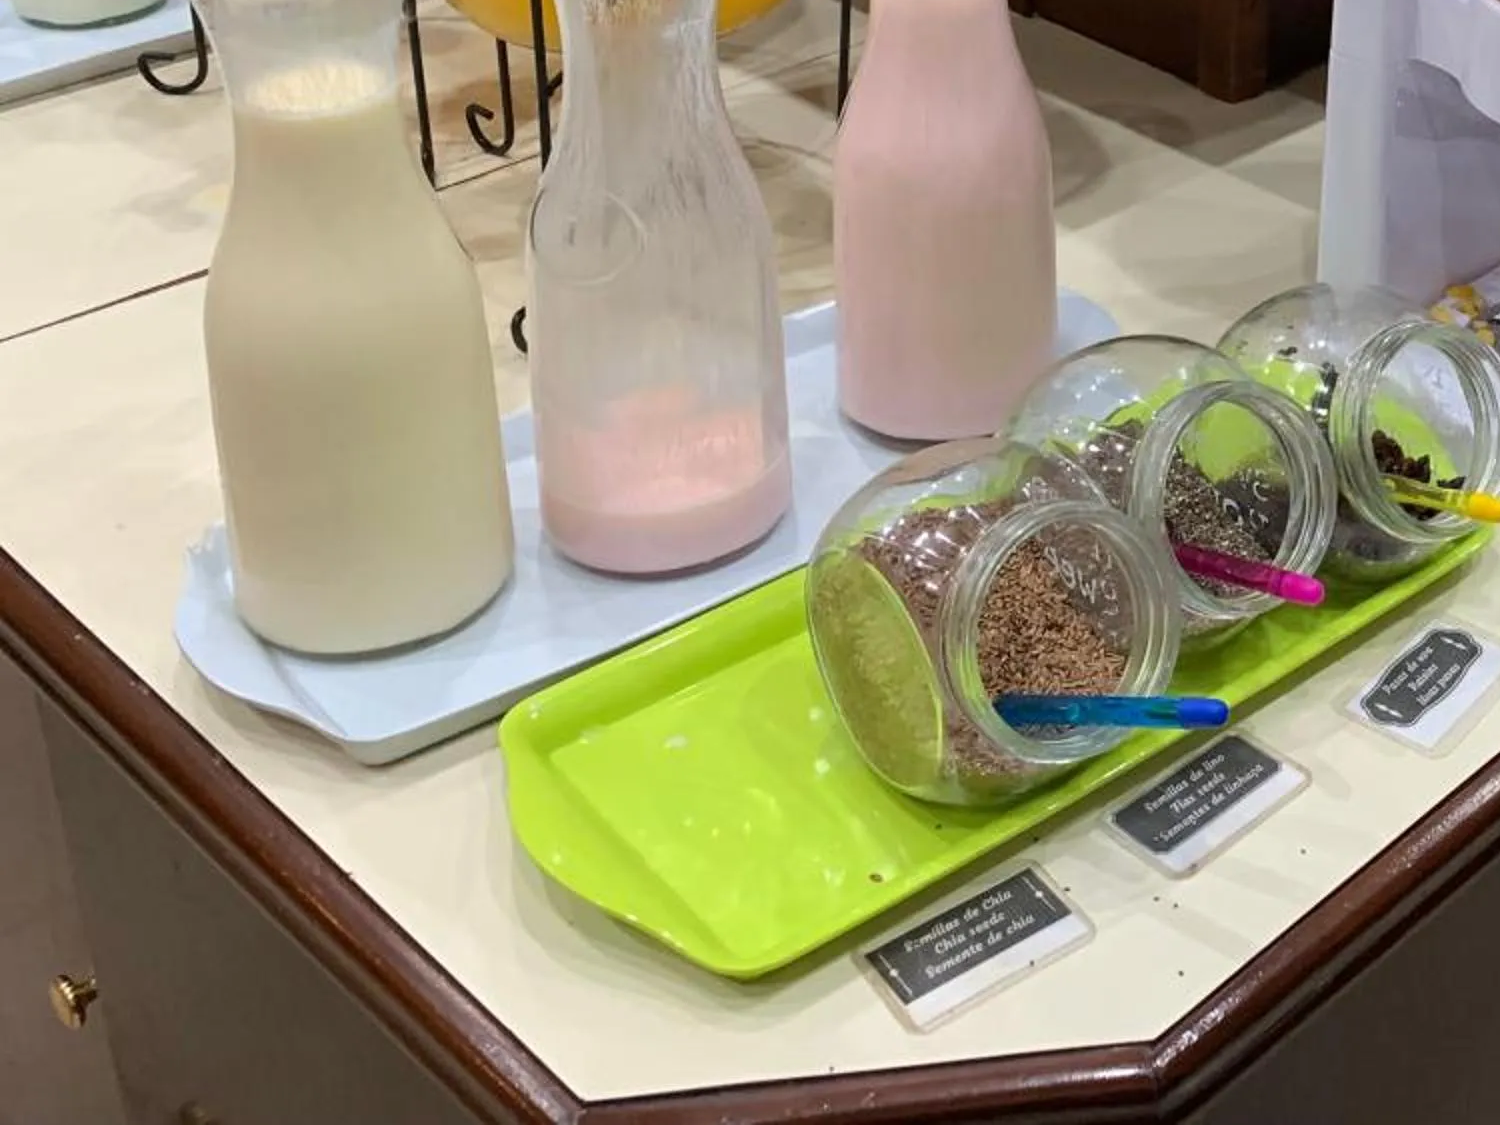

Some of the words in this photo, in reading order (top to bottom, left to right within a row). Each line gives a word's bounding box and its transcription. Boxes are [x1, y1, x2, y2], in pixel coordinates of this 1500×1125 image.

[963, 905, 980, 923] de
[982, 888, 1014, 910] Chia
[924, 944, 985, 980] Semente
[986, 930, 1004, 947] de
[934, 932, 967, 955] Chia
[968, 911, 1006, 936] seeds
